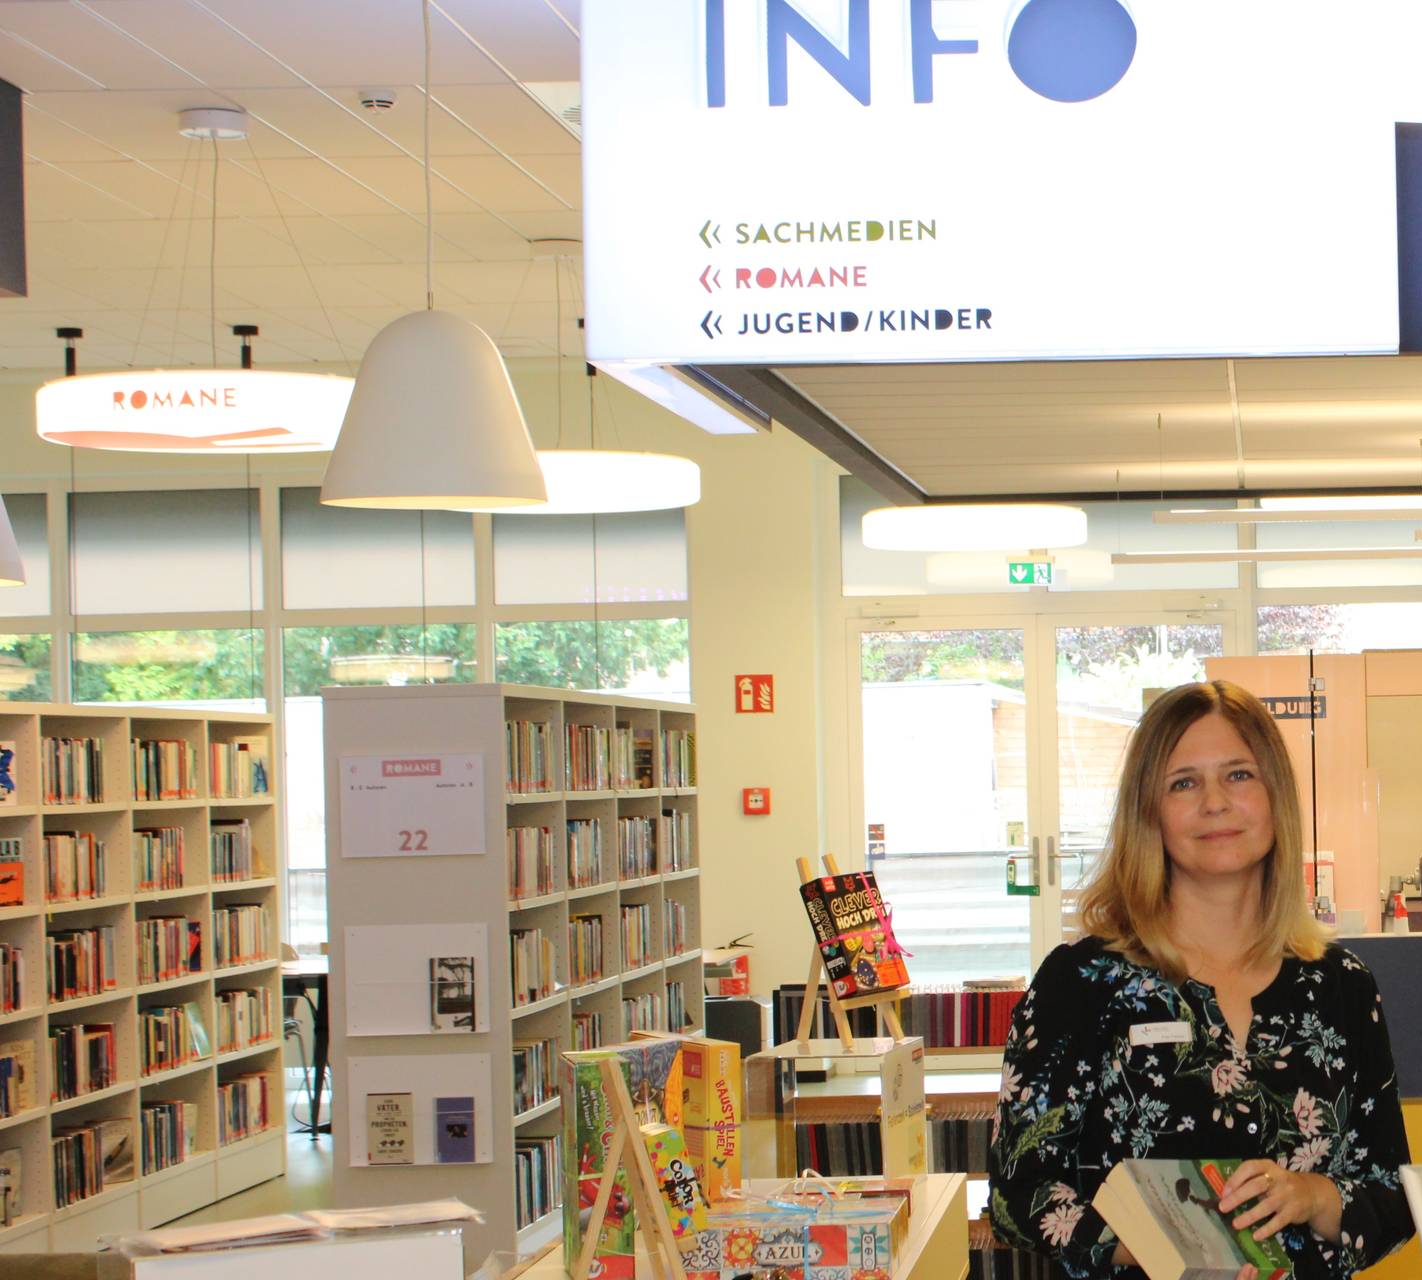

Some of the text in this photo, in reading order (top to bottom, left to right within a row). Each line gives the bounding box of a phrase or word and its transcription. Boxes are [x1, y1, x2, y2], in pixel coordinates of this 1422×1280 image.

[705, 0, 1138, 107] INFO
[734, 219, 938, 245] SACHMEDIEN
[735, 265, 868, 289] ROMANE
[737, 308, 993, 335] JUGEND/KINDER
[112, 386, 238, 411] ROMANE
[386, 763, 437, 773] ROMANE
[398, 830, 429, 851] 22
[831, 888, 881, 917] CLEVER
[836, 912, 862, 930] HOCH
